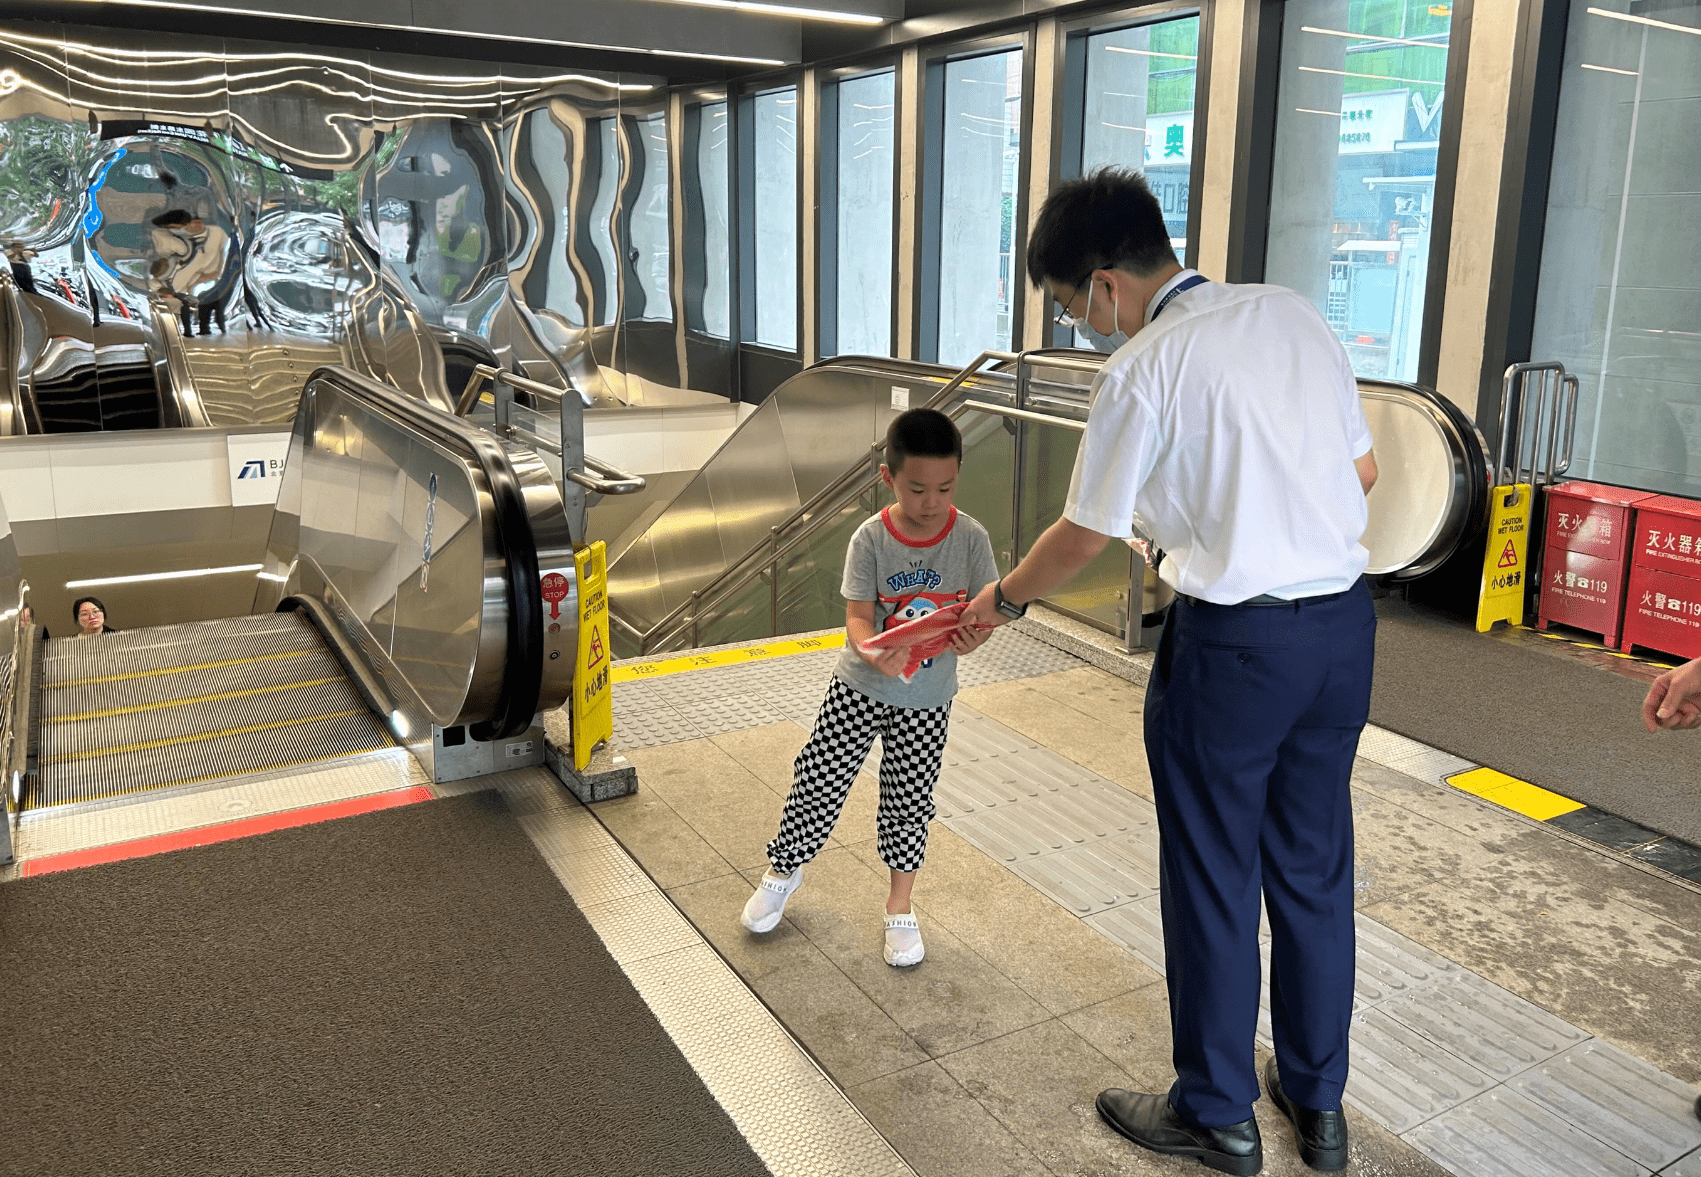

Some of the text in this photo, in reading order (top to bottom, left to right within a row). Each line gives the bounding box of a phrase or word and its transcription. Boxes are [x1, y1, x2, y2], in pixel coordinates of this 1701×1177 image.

[1163, 123, 1185, 157] 奥
[1497, 524, 1524, 535] WET FLOOR
[1501, 516, 1523, 526] CAUTION
[1557, 512, 1612, 538] 灭火箱
[1645, 548, 1657, 556] FIRE
[1657, 551, 1694, 563] EXTINGUISHER
[543, 576, 565, 588] 急停
[1491, 571, 1521, 590] 小心地滑
[1590, 579, 1608, 593] 119
[585, 589, 603, 609] CAUTION
[1551, 587, 1564, 595] FIRE
[1564, 589, 1595, 602] TELEPHONE
[583, 598, 606, 622] WET FLOOR
[1682, 600, 1701, 616] 119
[1638, 607, 1700, 628] FIRE TELEPHONE 119
[585, 664, 608, 703] 小心地滑
